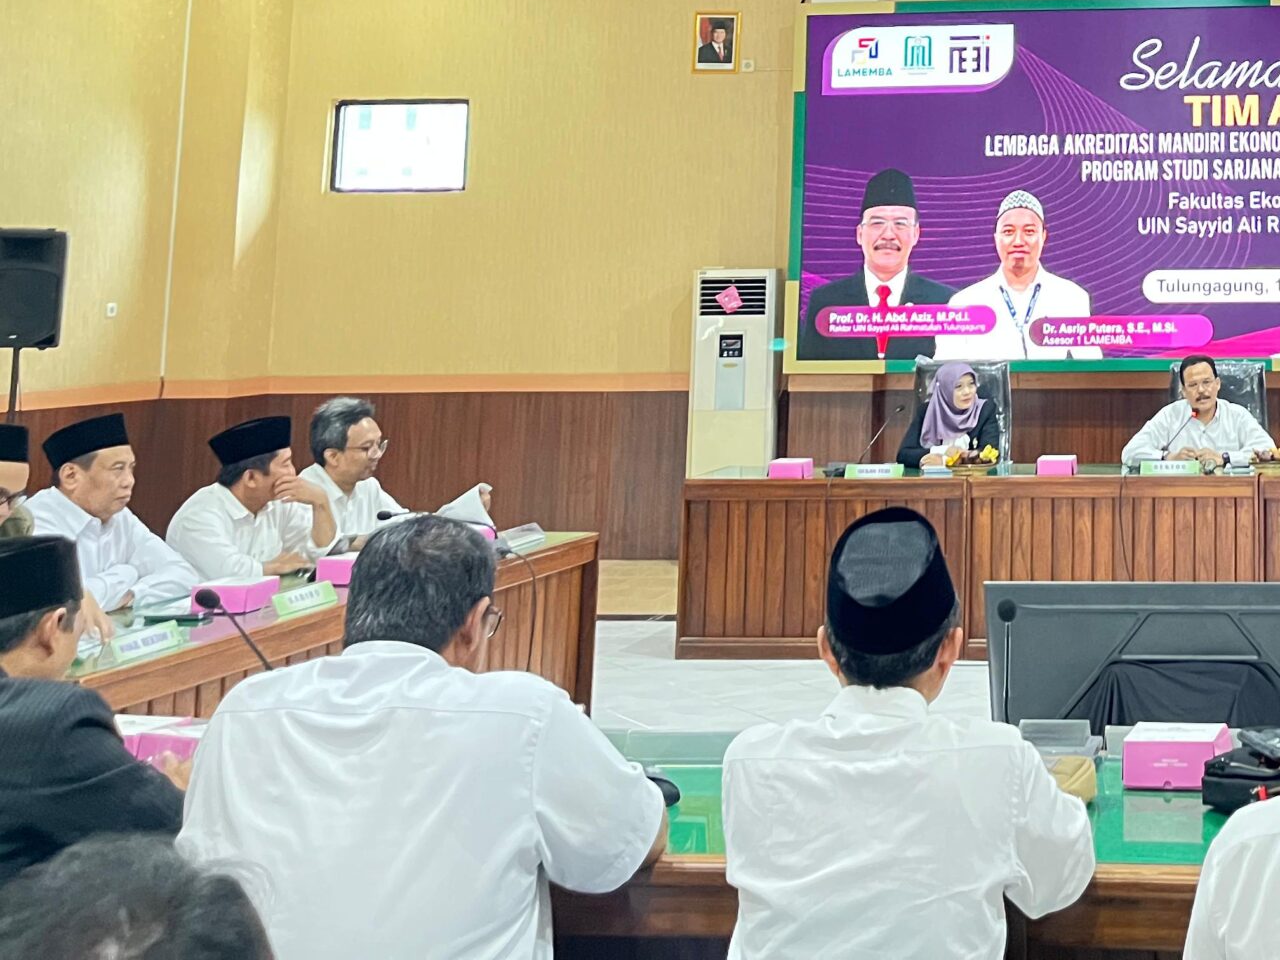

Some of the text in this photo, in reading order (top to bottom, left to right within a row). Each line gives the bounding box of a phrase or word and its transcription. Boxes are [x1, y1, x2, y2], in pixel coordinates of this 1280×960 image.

[837, 67, 893, 78] LAMEMBA
[1183, 93, 1260, 127] TIM
[985, 134, 1060, 157] LEMBAGA
[1063, 132, 1154, 155] AKREDITASI
[1158, 131, 1225, 154] MANDIRI
[1081, 160, 1158, 182] PROGRAM
[1162, 159, 1209, 180] STUDI
[1168, 191, 1245, 210] Fakultas
[1137, 217, 1170, 235] UIN
[1175, 216, 1234, 238] Sayyid
[1238, 215, 1262, 234] Ali
[1156, 278, 1269, 296] Tulungagung,
[829, 312, 854, 324] Prof.
[855, 313, 870, 323] Dr.
[872, 313, 883, 323] H.
[885, 312, 908, 323] Abd.
[1042, 323, 1058, 334] Dr.
[1042, 335, 1133, 345] Asesor 1 LAMEMBA
